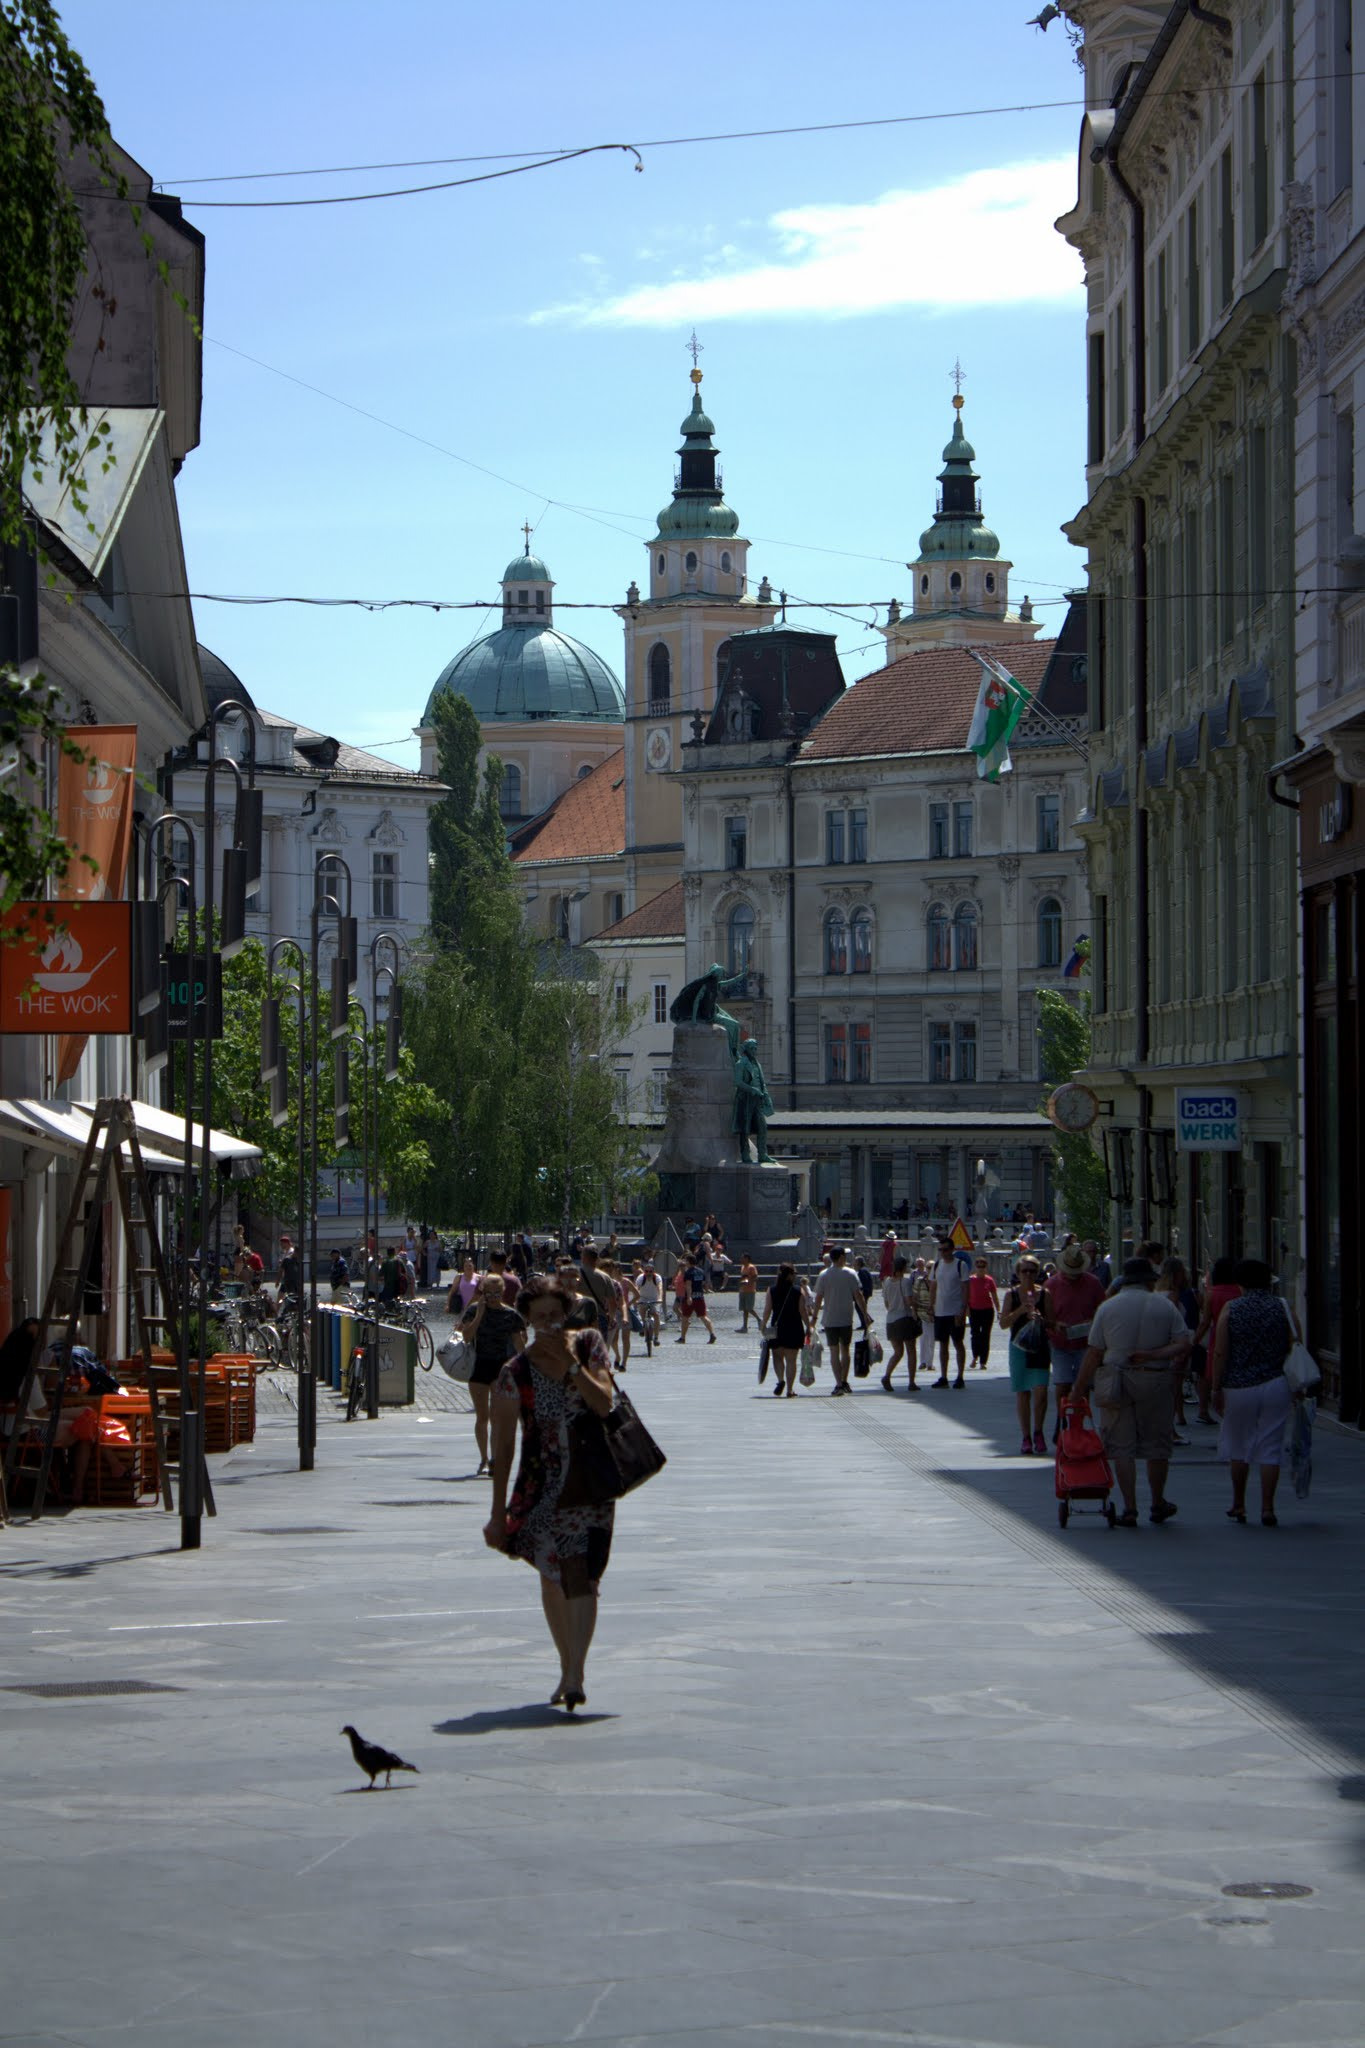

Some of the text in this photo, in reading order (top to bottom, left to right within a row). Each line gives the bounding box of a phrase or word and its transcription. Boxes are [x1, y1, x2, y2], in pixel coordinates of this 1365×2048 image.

[72, 807, 95, 821] THE
[15, 996, 56, 1014] THE
[1184, 1099, 1234, 1117] back
[1181, 1123, 1237, 1141] WERK
